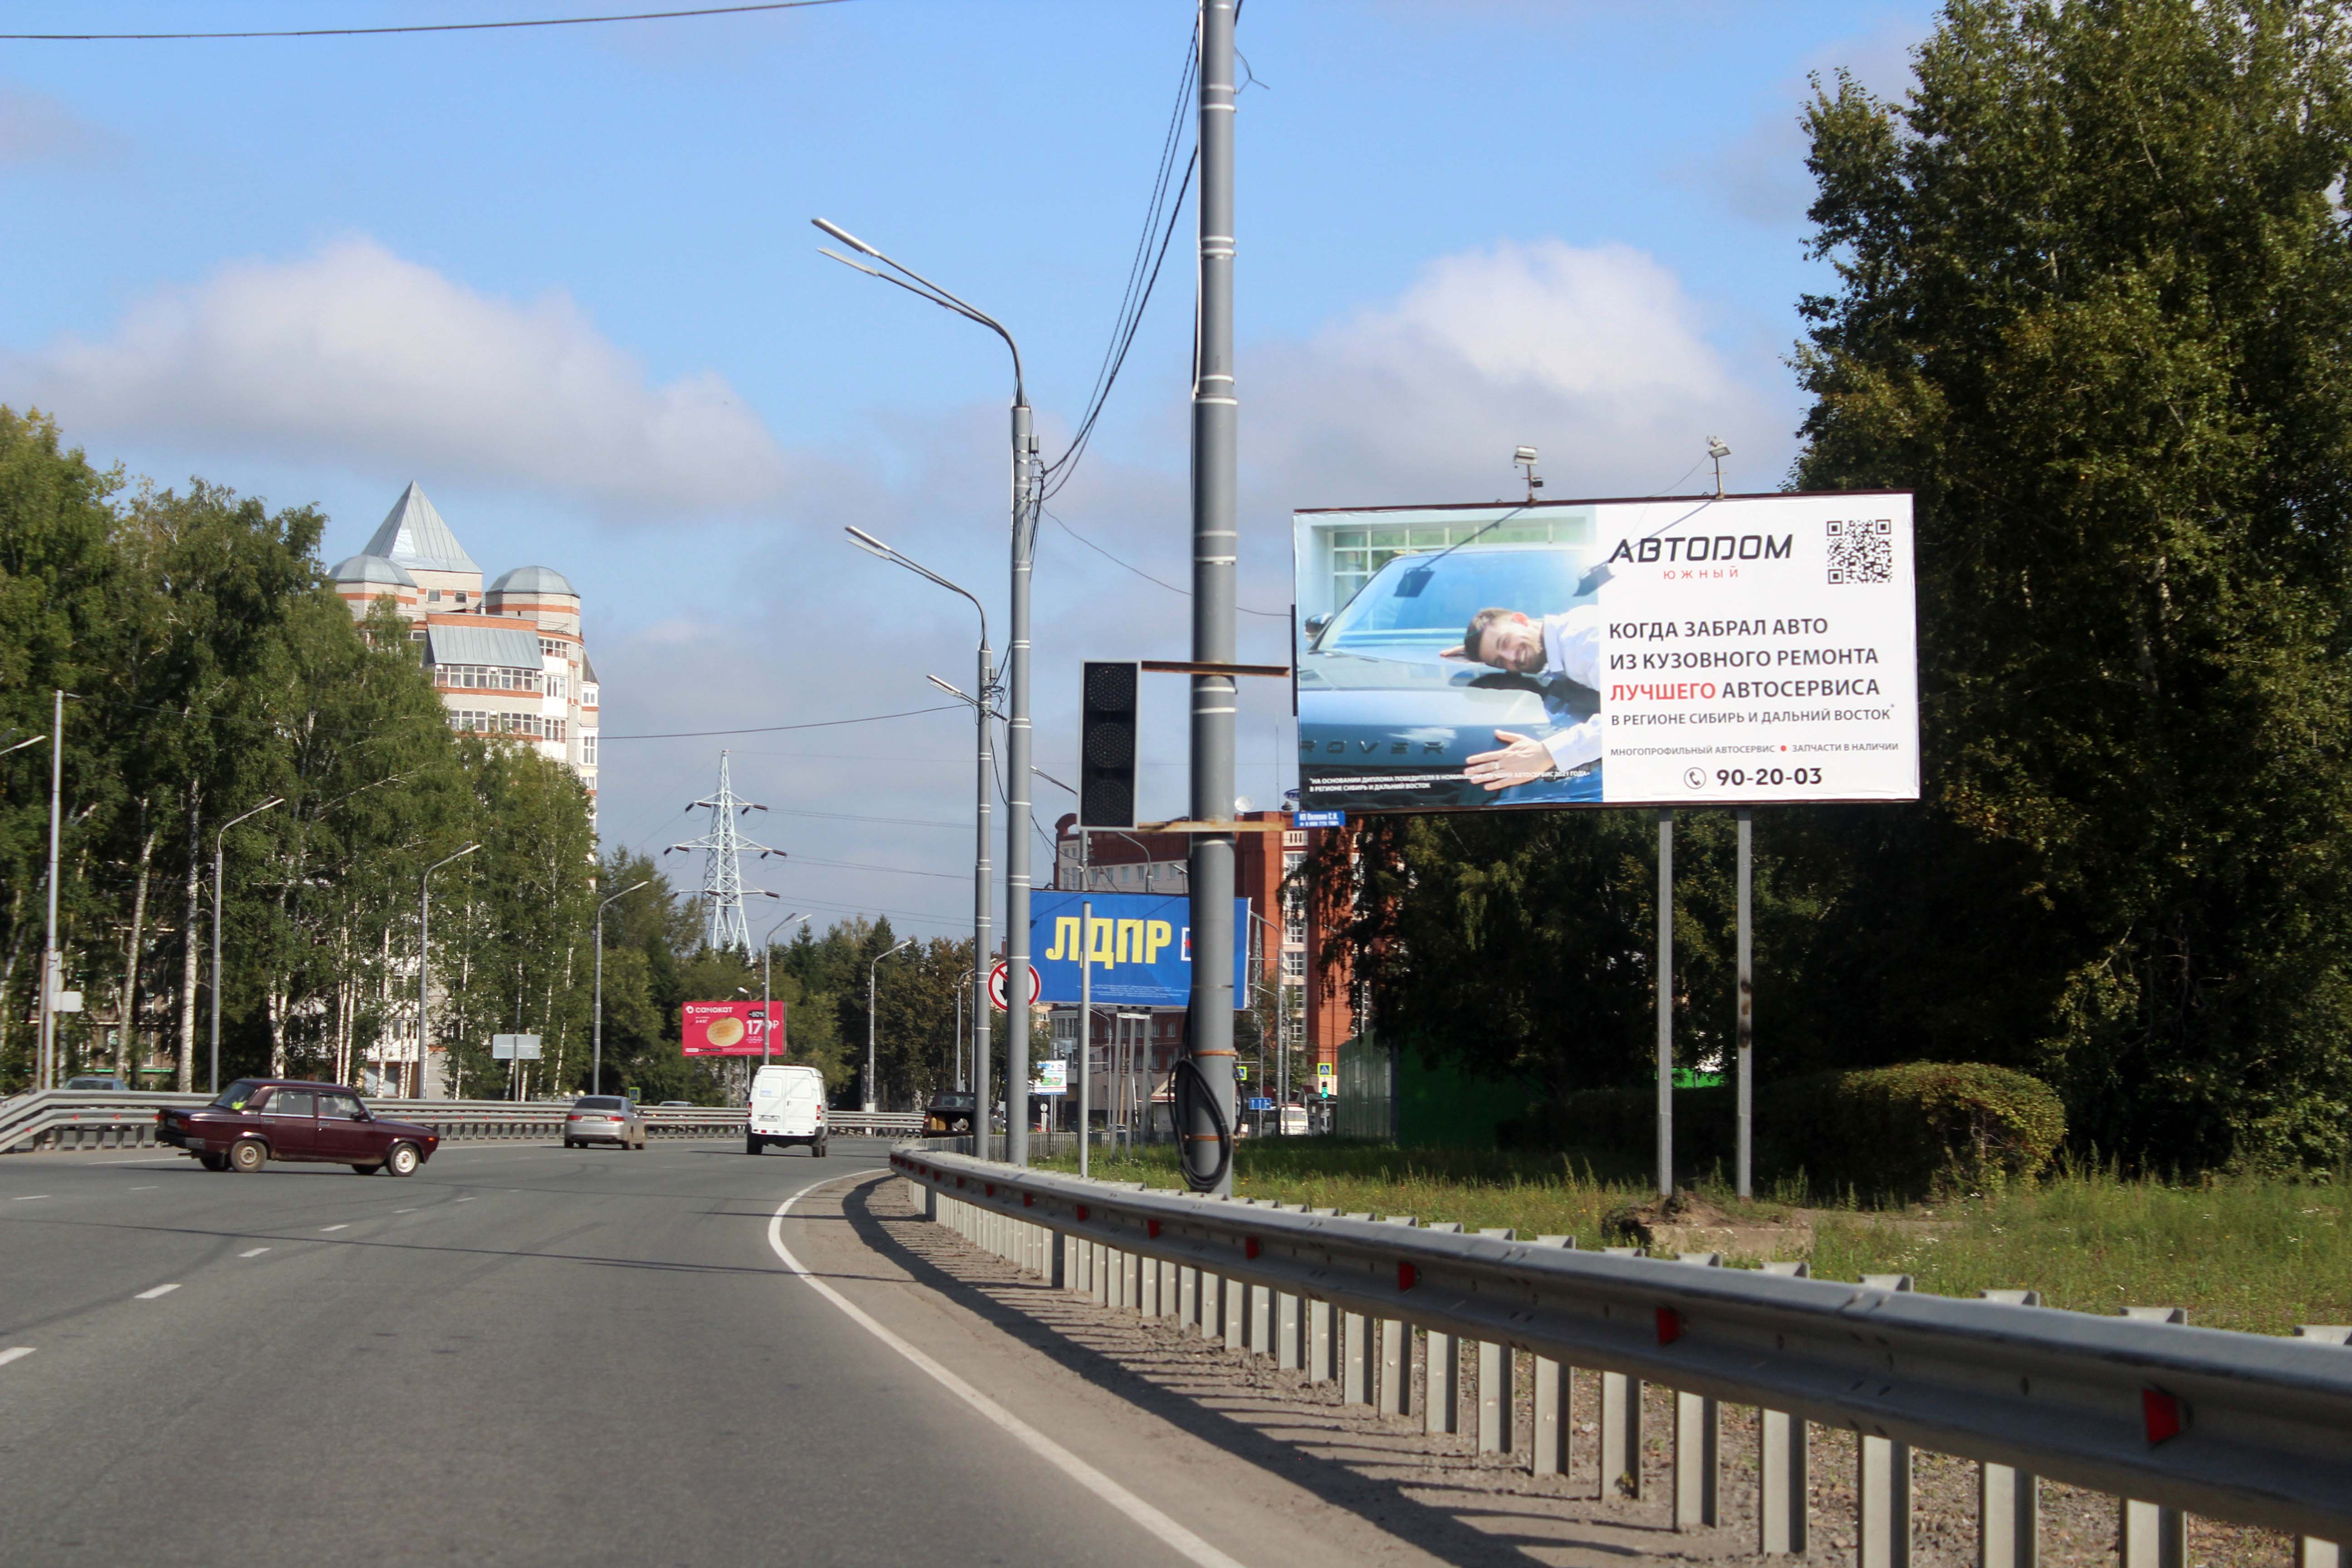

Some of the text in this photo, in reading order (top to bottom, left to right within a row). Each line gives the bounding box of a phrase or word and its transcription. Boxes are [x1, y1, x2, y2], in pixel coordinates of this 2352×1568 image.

[1663, 566, 1738, 580] ЮЖНЫЙ
[1610, 618, 1828, 642] КОГДА ЗАБРАЛ АВТО
[1611, 648, 1878, 670] ИЗ КУЗОВНОГО РЕМОНТА
[1610, 679, 1881, 701] ЛУЧШЕГО АВТОСЕРВИСА
[1611, 715, 1619, 725] В
[1623, 713, 1686, 725] РЕГИОНЕ
[1689, 712, 1744, 724] СИБИРЬ
[1749, 712, 1758, 722] И
[1761, 708, 1830, 725] ДАЛЬНИЙ
[1610, 745, 1775, 756] МНОГОПРОФИЛЬНЫЙ АВТОСЕРВИС
[1792, 743, 1841, 752] ЗАПЧАСТИ
[1852, 743, 1899, 751] НАЛИЧИИ
[1717, 768, 1822, 786] 90-20-03
[1045, 916, 1171, 970] ЛДПР
